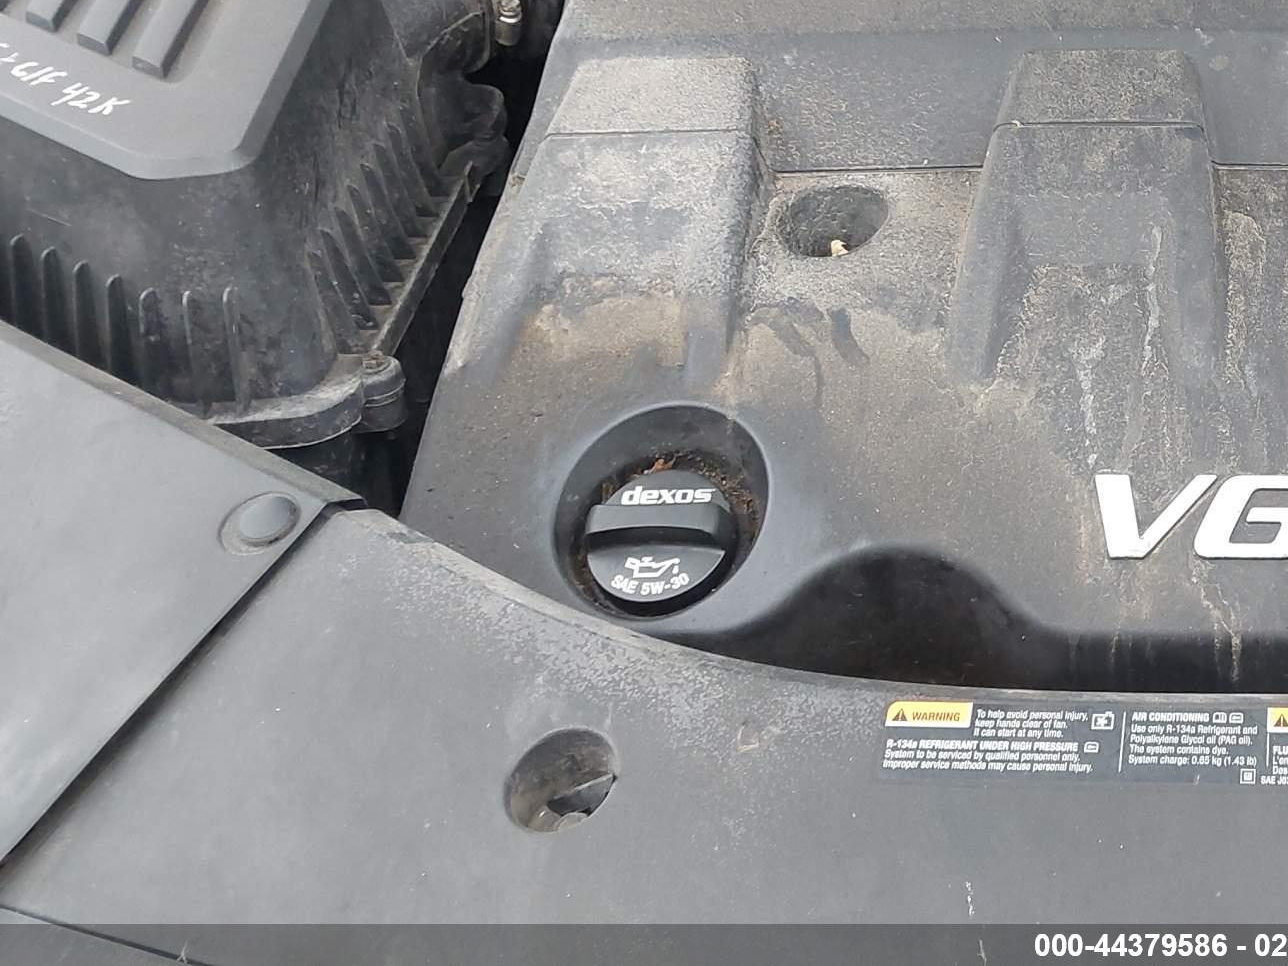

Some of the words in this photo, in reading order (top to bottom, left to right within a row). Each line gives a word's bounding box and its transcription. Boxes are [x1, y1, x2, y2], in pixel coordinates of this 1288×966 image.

[51, 82, 132, 115] 42K
[621, 486, 715, 505] dexos
[611, 574, 638, 595] SAE
[640, 572, 690, 596] 5W-30
[912, 712, 961, 721] WARNING
[976, 709, 986, 719] To
[987, 709, 1005, 720] help
[1006, 710, 1028, 719] avoid
[1029, 710, 1063, 721] personal
[1131, 712, 1147, 722] AIR
[1149, 712, 1210, 723] CONDITIONING
[975, 719, 995, 728] keep
[996, 719, 1020, 728] hands
[1021, 719, 1042, 728] clear
[1043, 720, 1052, 728] of
[1053, 720, 1068, 729] fan.
[1131, 724, 1147, 733] Use
[1147, 724, 1165, 735] only
[1166, 724, 1196, 734] R-134a
[1197, 725, 1241, 735] Refrigerant
[1242, 725, 1258, 734] and
[973, 728, 980, 737] It
[981, 729, 996, 737] can
[997, 729, 1016, 737] start
[1017, 729, 1026, 737] at
[1027, 730, 1042, 739] any
[1044, 729, 1063, 738] time.
[886, 739, 918, 749] R-134a
[919, 739, 978, 750] REFRIGERANT
[980, 740, 1009, 750] UNDER
[1010, 741, 1032, 751] HIGH
[1033, 741, 1079, 751] PRESSURE
[1130, 734, 1179, 744] Polyalkylene
[1181, 735, 1204, 745] Glycol
[1206, 735, 1216, 744] oil
[1218, 735, 1236, 745] (PAG
[1130, 744, 1144, 753] The
[1146, 745, 1175, 755] system
[1176, 745, 1210, 754] contains
[1211, 745, 1229, 755] dye.
[884, 749, 914, 759] System
[916, 749, 925, 759] to
[926, 749, 936, 759] be
[938, 750, 972, 759] serviced
[973, 750, 984, 761] by
[985, 751, 1020, 761] qualified
[1021, 751, 1060, 762] personnel
[1061, 752, 1080, 763] only.
[1128, 754, 1158, 765] System
[1159, 755, 1190, 766] charge:
[1211, 756, 1222, 766] kg
[1246, 756, 1257, 766] lb)
[883, 759, 920, 770] Improper
[920, 760, 950, 769] service
[951, 760, 987, 770] methods
[988, 762, 1006, 772] may
[1007, 762, 1031, 771] cause
[1032, 762, 1067, 772] personal
[1068, 763, 1093, 774] injury.
[1272, 766, 1288, 775] Des
[1260, 775, 1276, 785] SAE
